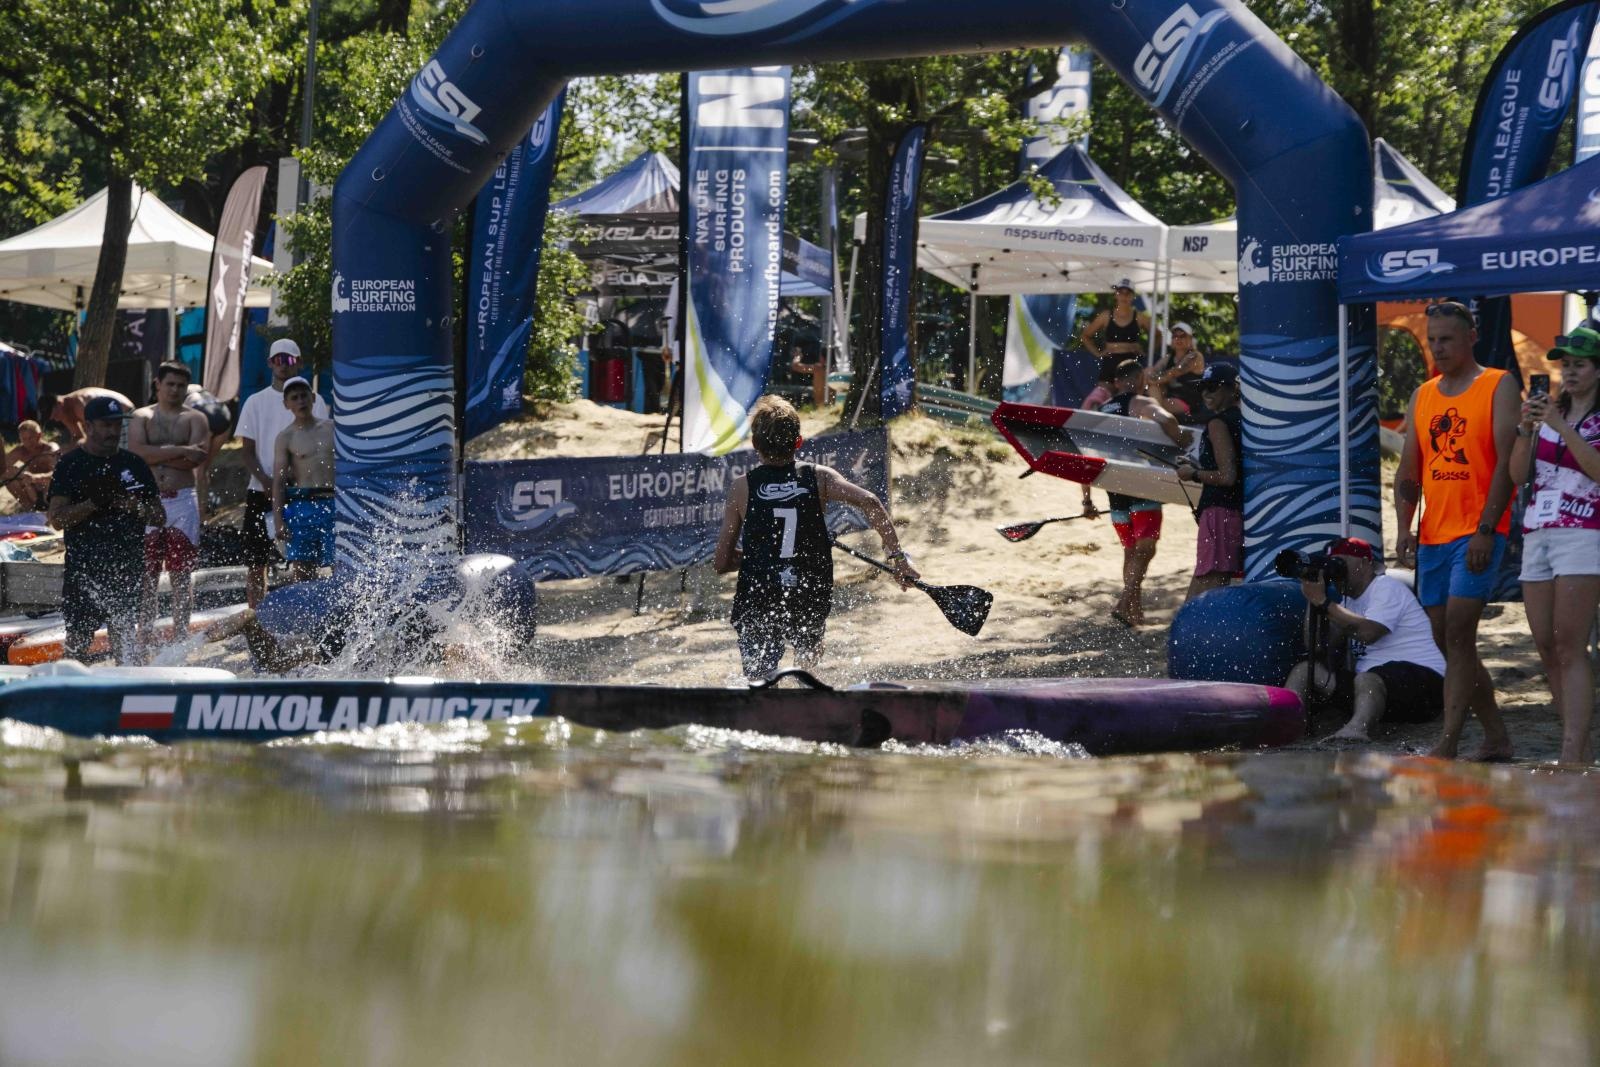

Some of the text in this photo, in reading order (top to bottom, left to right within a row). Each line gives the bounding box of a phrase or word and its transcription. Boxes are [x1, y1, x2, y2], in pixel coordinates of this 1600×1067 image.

[1538, 38, 1570, 110] ESL
[1486, 69, 1522, 197] UP LEAGUE
[488, 197, 503, 236] SUP
[696, 169, 709, 244] NATURE
[715, 169, 729, 251] SURFING
[730, 169, 746, 273] PRODUCTS
[1003, 227, 1144, 249] nspsurfboards.com
[1182, 236, 1209, 252] NSP
[1271, 243, 1338, 258] EUROPEA
[1381, 248, 1439, 277] ESL
[1481, 245, 1600, 270] EUROPE
[351, 279, 415, 290] EUROPEAN
[351, 290, 416, 303] SURFING
[351, 303, 416, 312] FEDERATION
[608, 467, 725, 500] EUROPEAN
[773, 507, 798, 559] 7
[186, 694, 540, 731] MIKOŁAJ MICZEK
